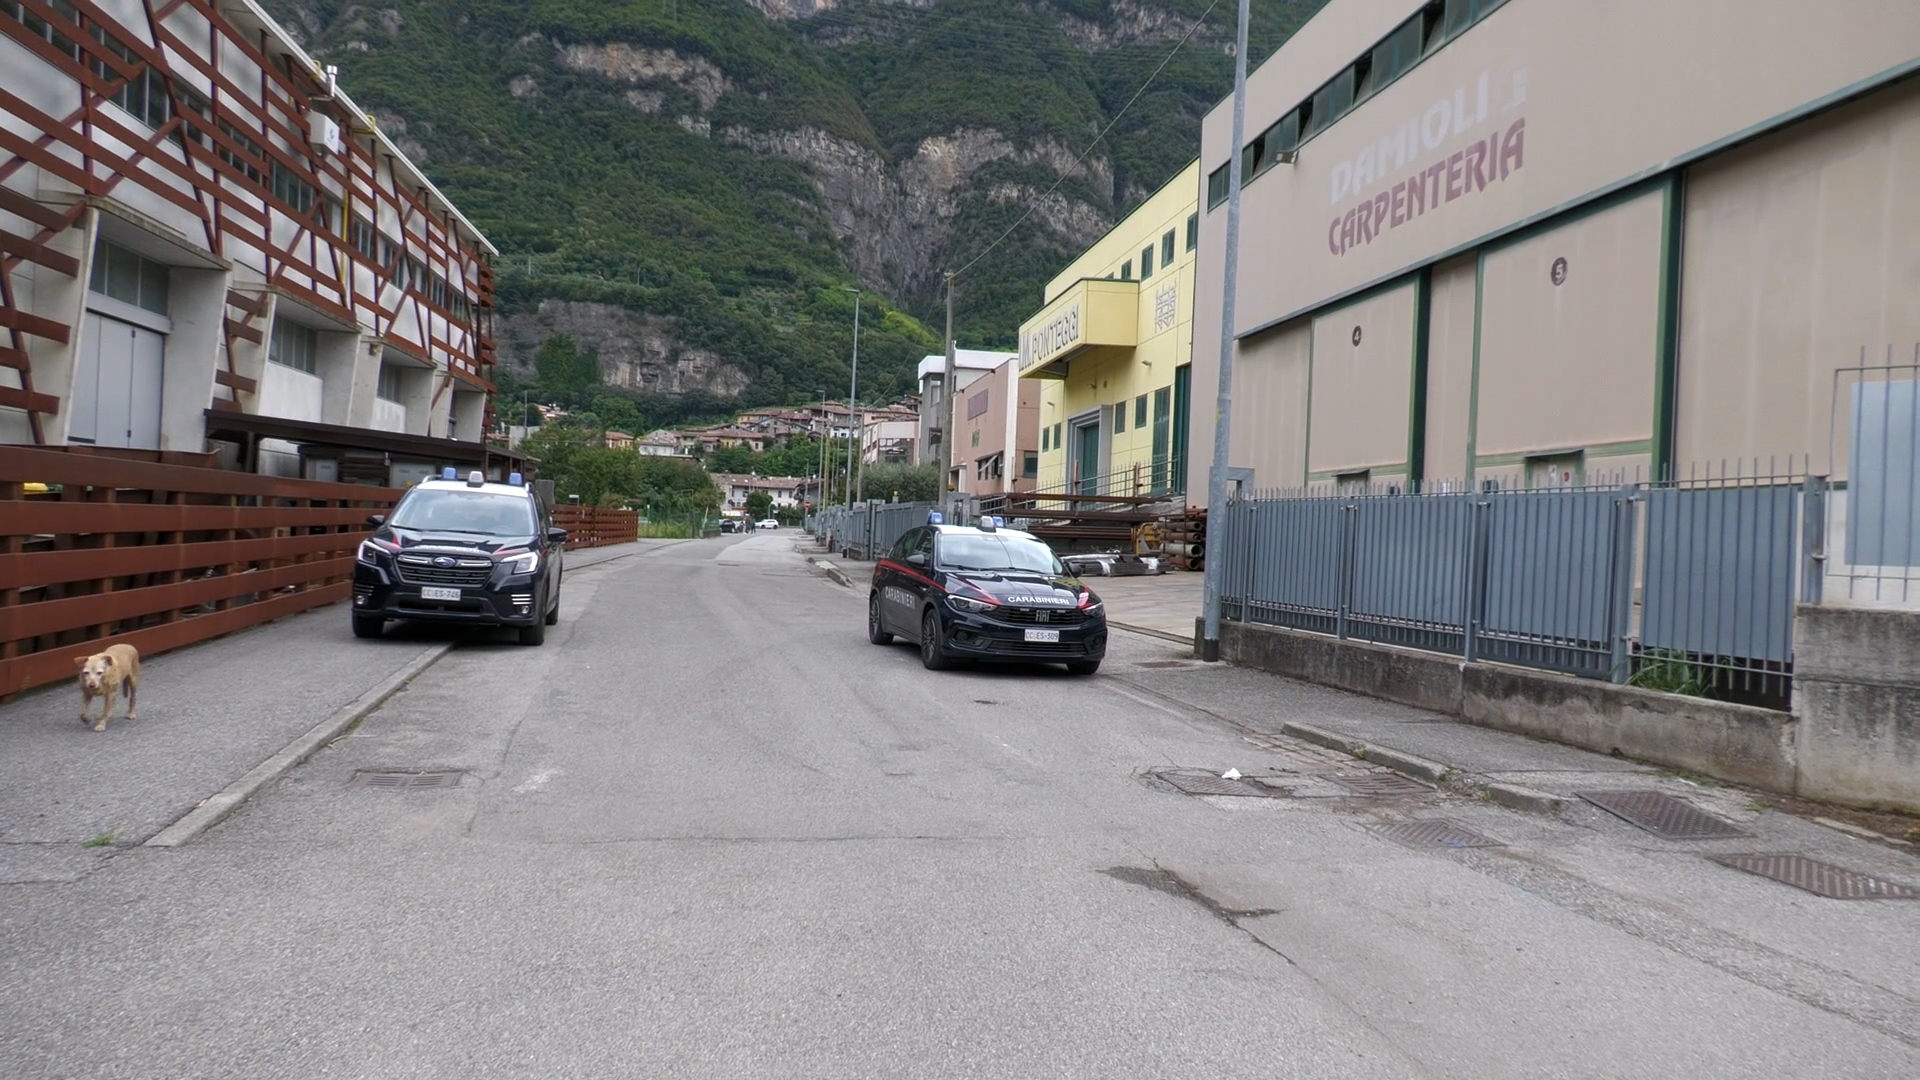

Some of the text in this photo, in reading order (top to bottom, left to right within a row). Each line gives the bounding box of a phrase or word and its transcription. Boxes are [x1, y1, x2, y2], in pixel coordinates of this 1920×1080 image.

[1331, 71, 1489, 206] DAMIOLI
[1328, 116, 1526, 257] CARPENTERIA
[885, 586, 916, 609] CARABINIERI
[1007, 596, 1070, 605] CARABINIERI
[1035, 610, 1051, 622] FIAT
